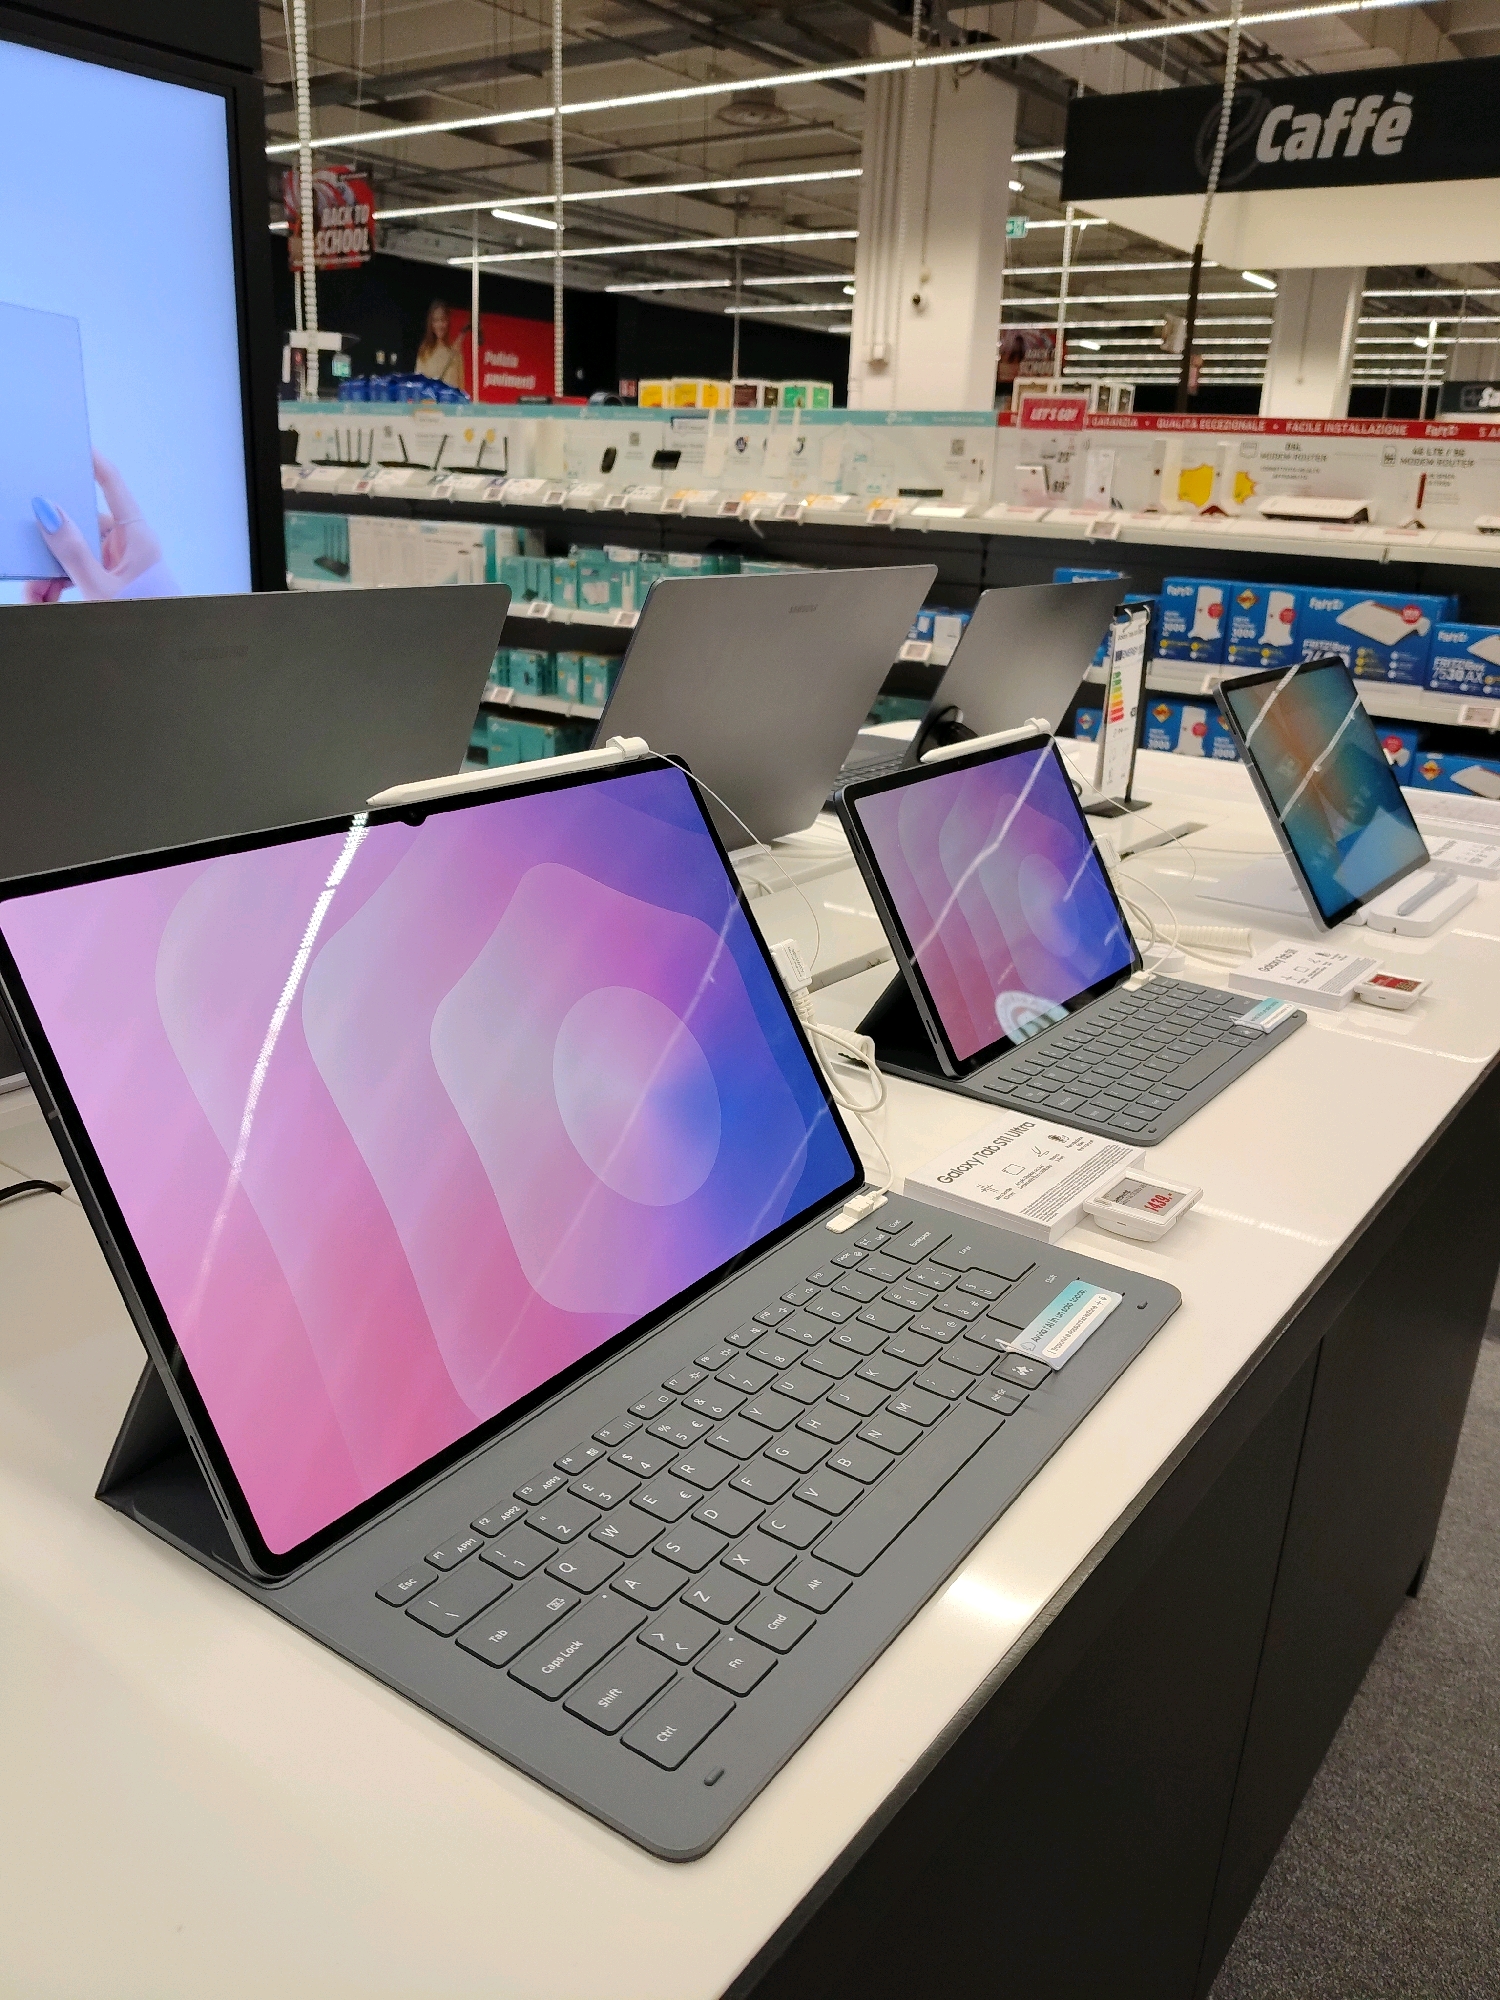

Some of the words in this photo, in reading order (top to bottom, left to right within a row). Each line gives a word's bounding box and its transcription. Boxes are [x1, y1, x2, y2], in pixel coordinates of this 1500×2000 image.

[1256, 90, 1413, 164] Caffè
[321, 206, 354, 228] BACK
[354, 203, 370, 225] TO
[316, 227, 370, 256] SCHOOL
[1199, 418, 1268, 433] ECCEZIONALE
[1285, 422, 1323, 435] FACILE
[1323, 423, 1410, 437] INSTALLAZIONE
[1399, 457, 1435, 468] MODEM
[1436, 459, 1476, 468] ROUTER
[936, 1156, 983, 1185] Galaxy
[1004, 1120, 1037, 1141] Ultra
[865, 1368, 880, 1377] K
[780, 1381, 795, 1390] U
[749, 1407, 763, 1416] Y
[895, 1402, 912, 1413] M
[806, 1419, 822, 1429] H
[675, 1432, 688, 1441] 5
[715, 1434, 730, 1443] T
[867, 1429, 883, 1439] N
[775, 1447, 790, 1456] G
[640, 1461, 652, 1470] 4
[836, 1457, 852, 1468] B
[680, 1464, 696, 1474] R
[740, 1476, 753, 1487] F
[520, 1485, 533, 1495] F3
[803, 1487, 819, 1497] V
[598, 1492, 612, 1501] 3
[642, 1494, 658, 1505] E
[478, 1516, 492, 1526] F2
[500, 1505, 521, 1522] APP2
[703, 1509, 719, 1520] D
[556, 1524, 572, 1534] 2
[771, 1519, 787, 1530] C
[600, 1524, 620, 1538] W
[432, 1550, 445, 1560] F1
[456, 1537, 478, 1554] APP1
[665, 1541, 681, 1553] S
[513, 1559, 526, 1567] 1
[731, 1553, 751, 1566] X
[558, 1562, 578, 1573] Q
[397, 1577, 418, 1592] Esc
[624, 1579, 642, 1590] A
[807, 1579, 823, 1591] Alt
[692, 1590, 712, 1603] Z
[767, 1613, 789, 1631] Cmd
[488, 1629, 509, 1643] Tab
[541, 1651, 566, 1674] Caps
[561, 1640, 584, 1659] Lock
[728, 1658, 745, 1669] Fn
[597, 1688, 623, 1708] Shift
[656, 1725, 678, 1742] Ctrl
